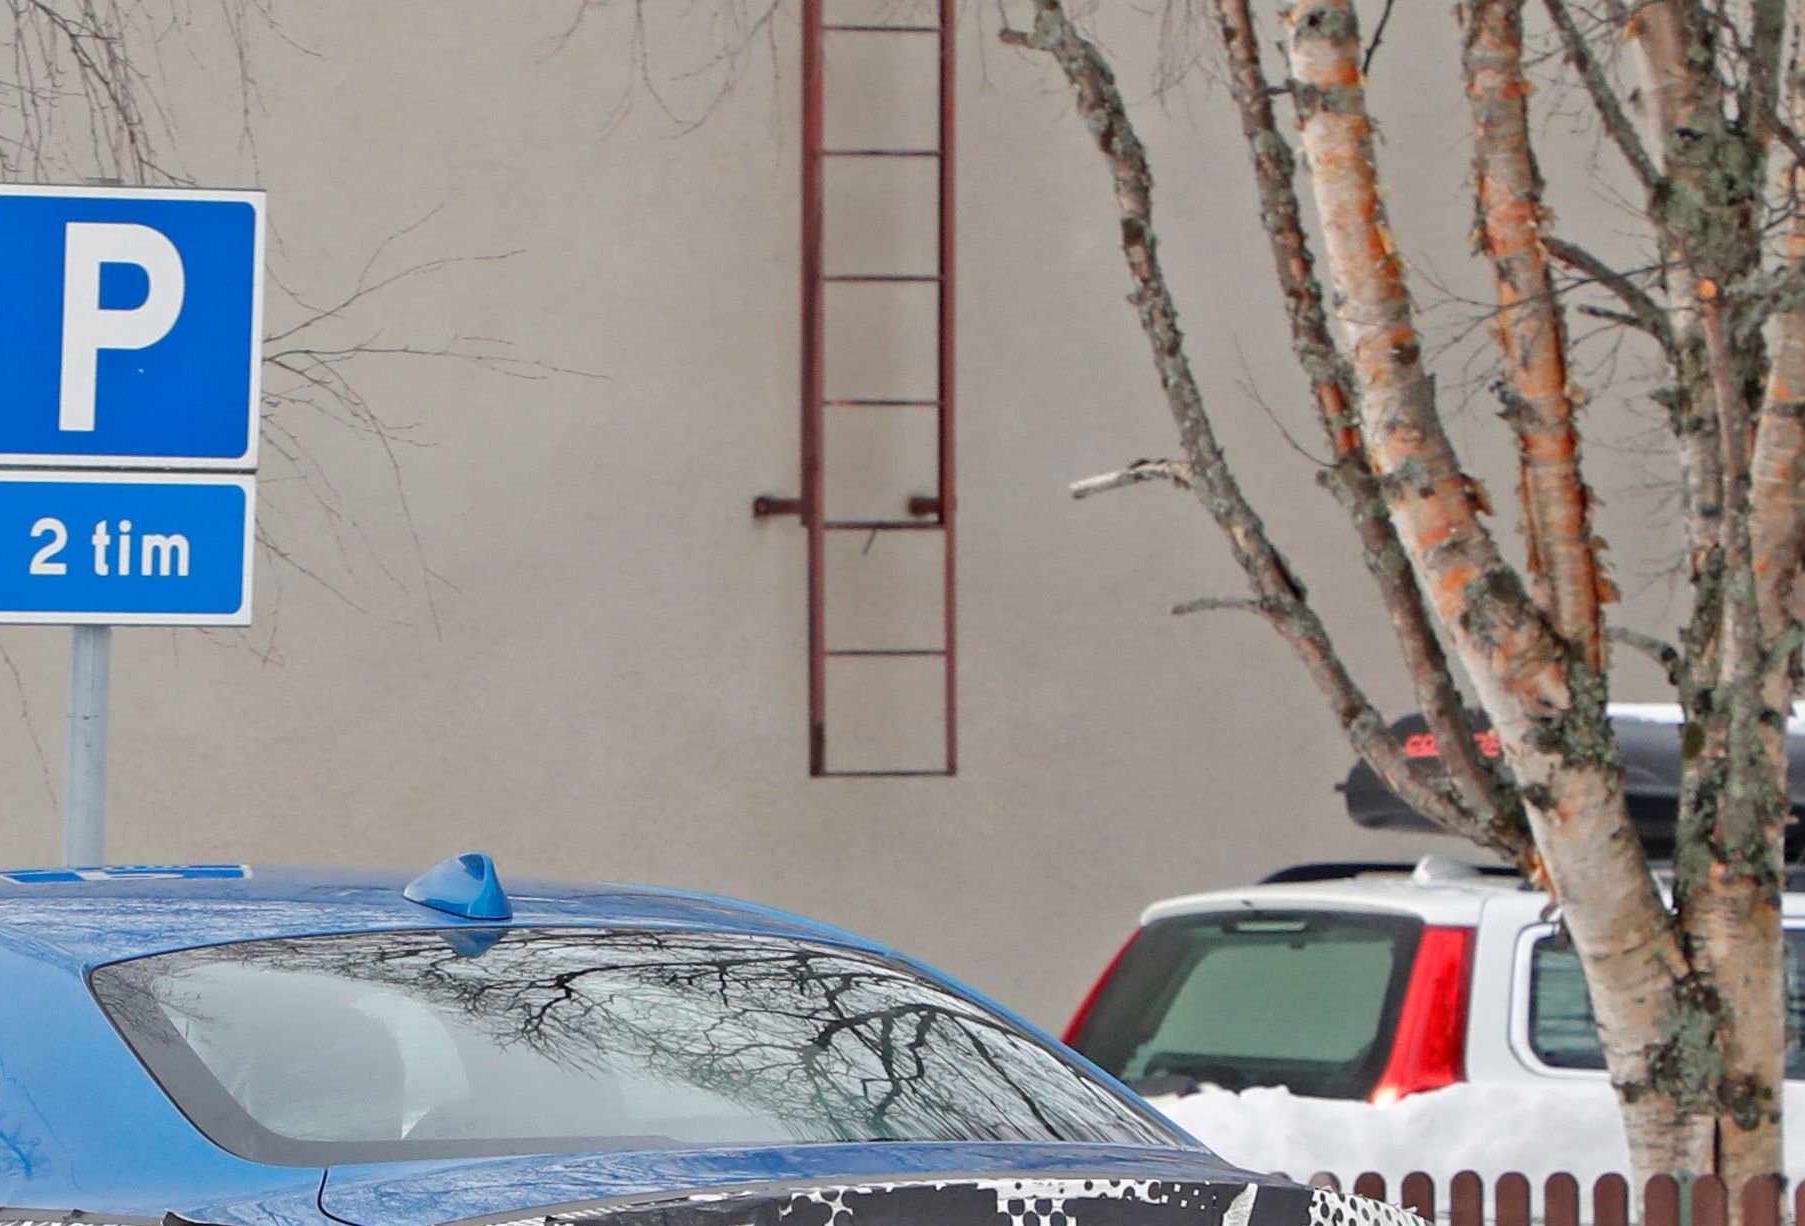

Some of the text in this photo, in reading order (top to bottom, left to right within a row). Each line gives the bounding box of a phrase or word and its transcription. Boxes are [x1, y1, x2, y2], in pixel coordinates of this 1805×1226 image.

[59, 222, 185, 432] P
[29, 517, 190, 577] 2 tim
